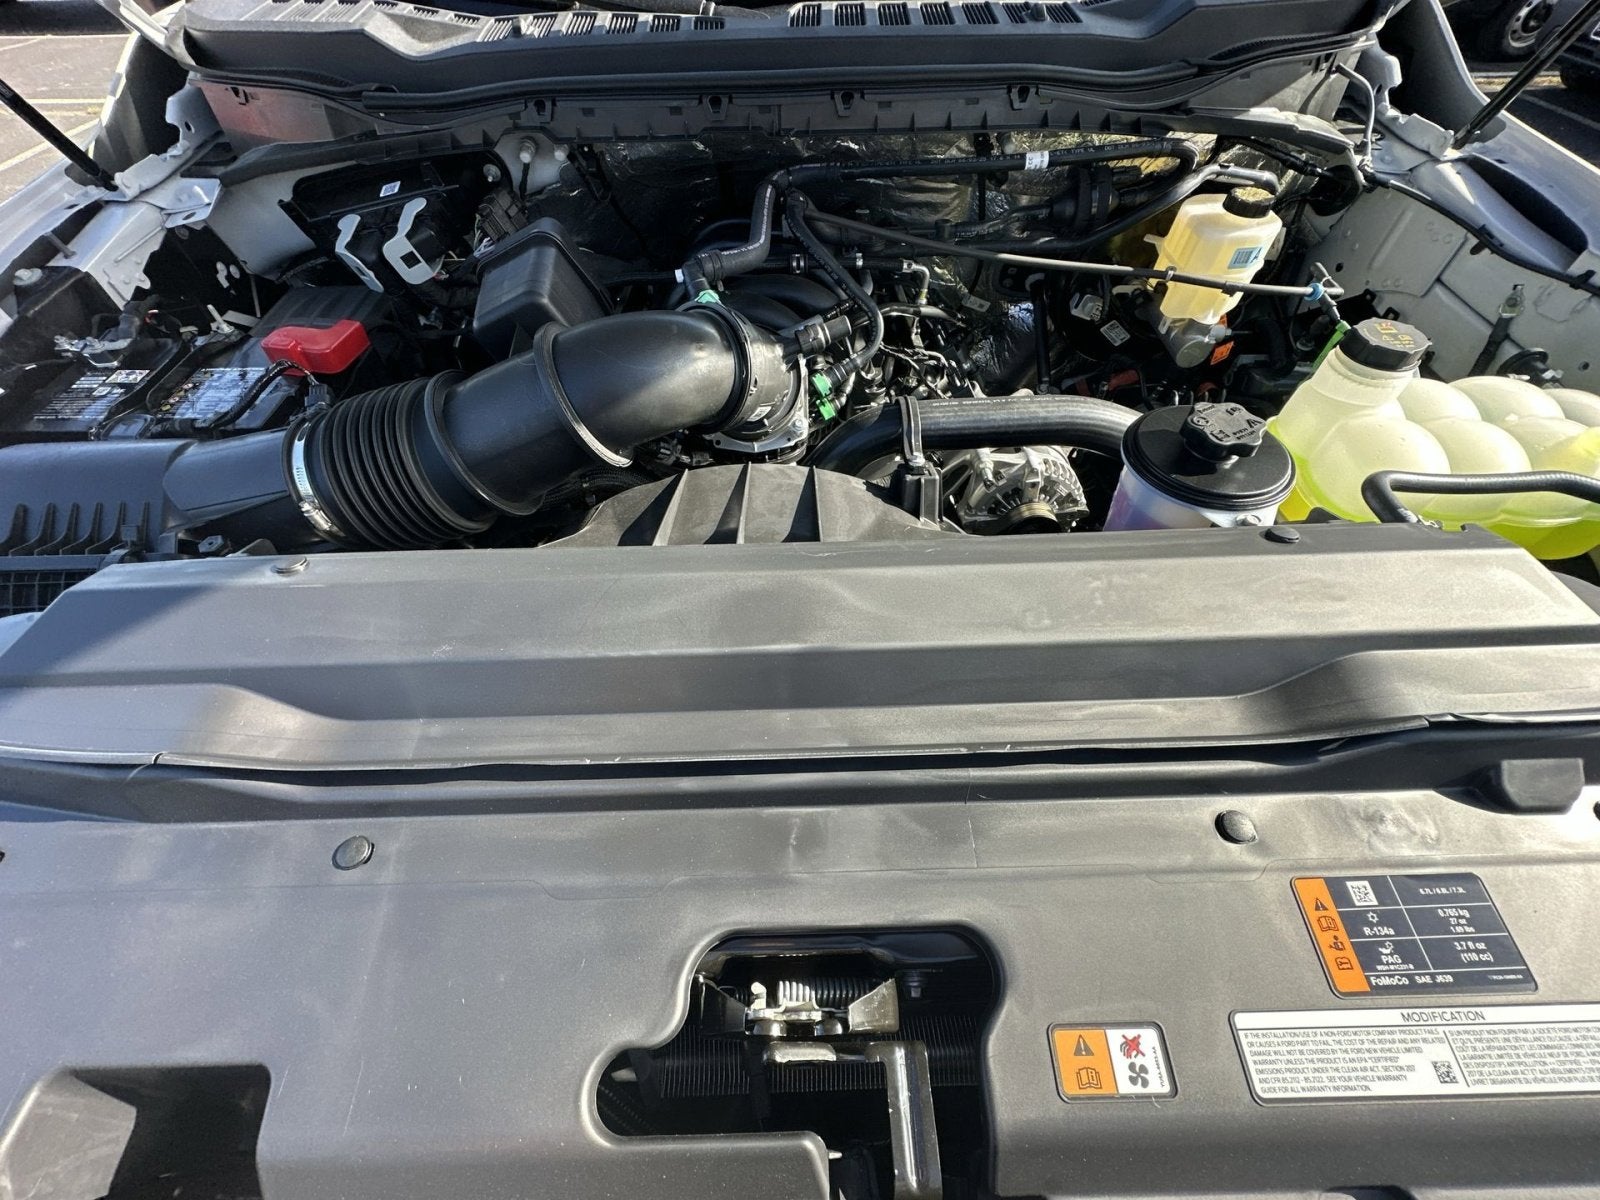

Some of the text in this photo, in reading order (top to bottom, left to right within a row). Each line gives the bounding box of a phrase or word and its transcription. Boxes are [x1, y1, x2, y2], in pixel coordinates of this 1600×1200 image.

[1363, 927, 1396, 936] R-134a
[1454, 942, 1467, 950] 3.7
[1381, 954, 1402, 964] PAG
[1461, 952, 1494, 963] (110 cc)
[1370, 975, 1409, 986] FoMoCo
[1415, 975, 1433, 984] SAE
[1400, 1010, 1486, 1022] MODIFICATION
